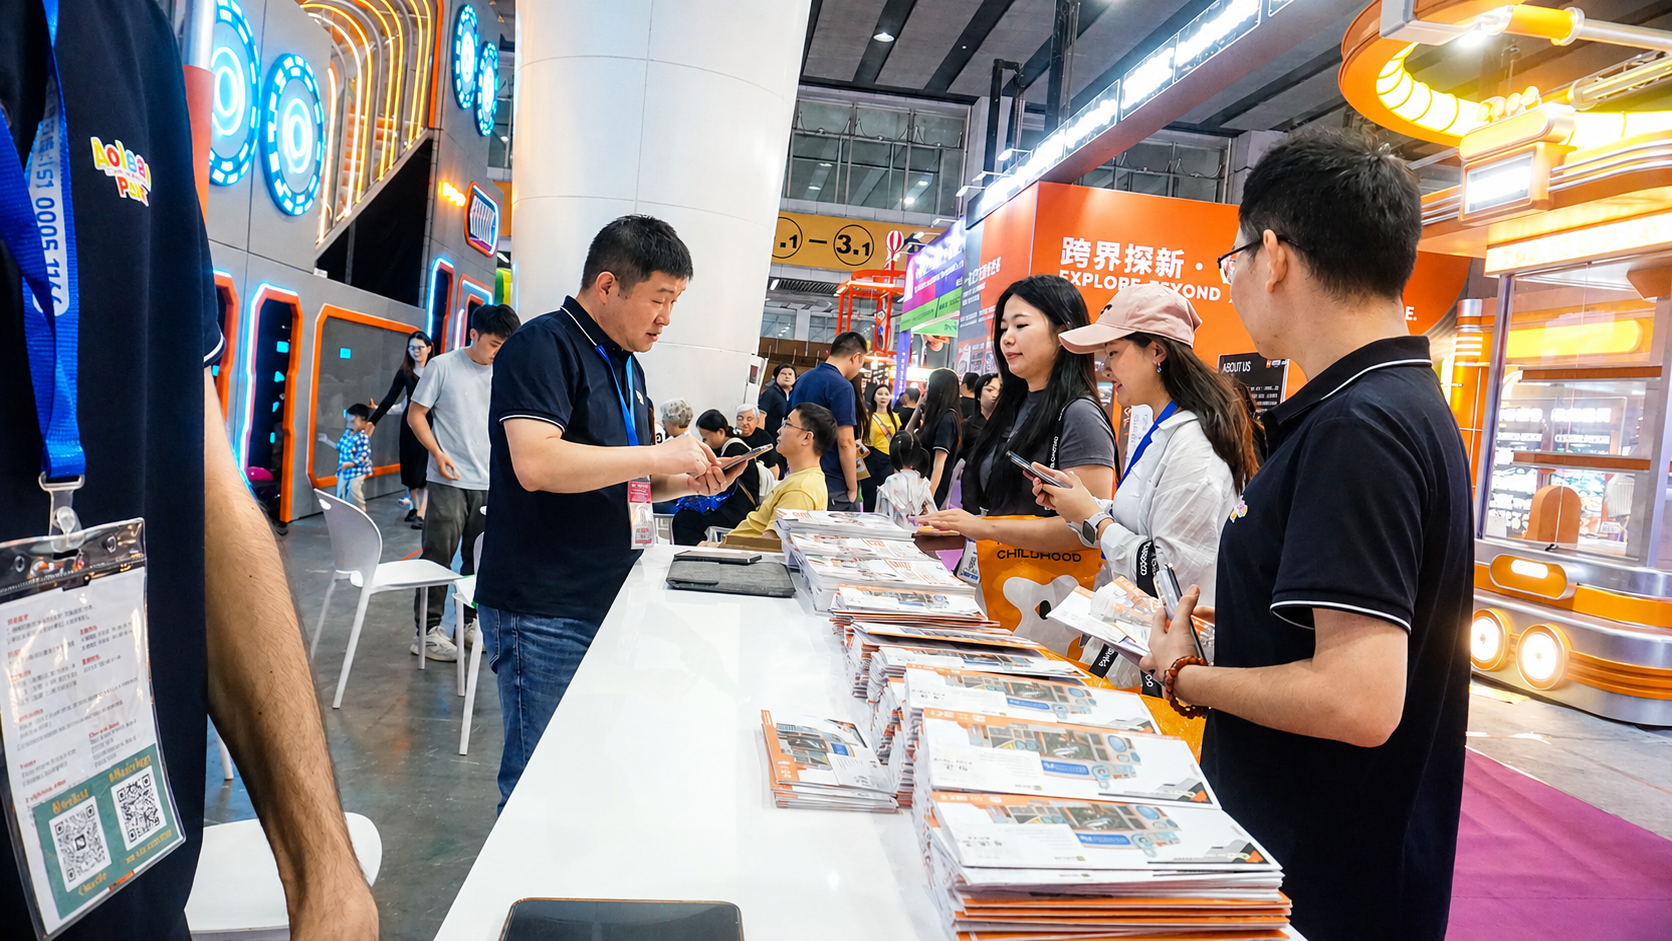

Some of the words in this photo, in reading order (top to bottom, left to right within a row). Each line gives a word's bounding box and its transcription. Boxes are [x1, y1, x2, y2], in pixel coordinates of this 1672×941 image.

[836, 234, 870, 256] 3.1
[1149, 280, 1221, 301] YOND
[1222, 362, 1241, 372] ABOUT
[1242, 361, 1251, 372] US
[997, 549, 1082, 562] CHILDHOOD
